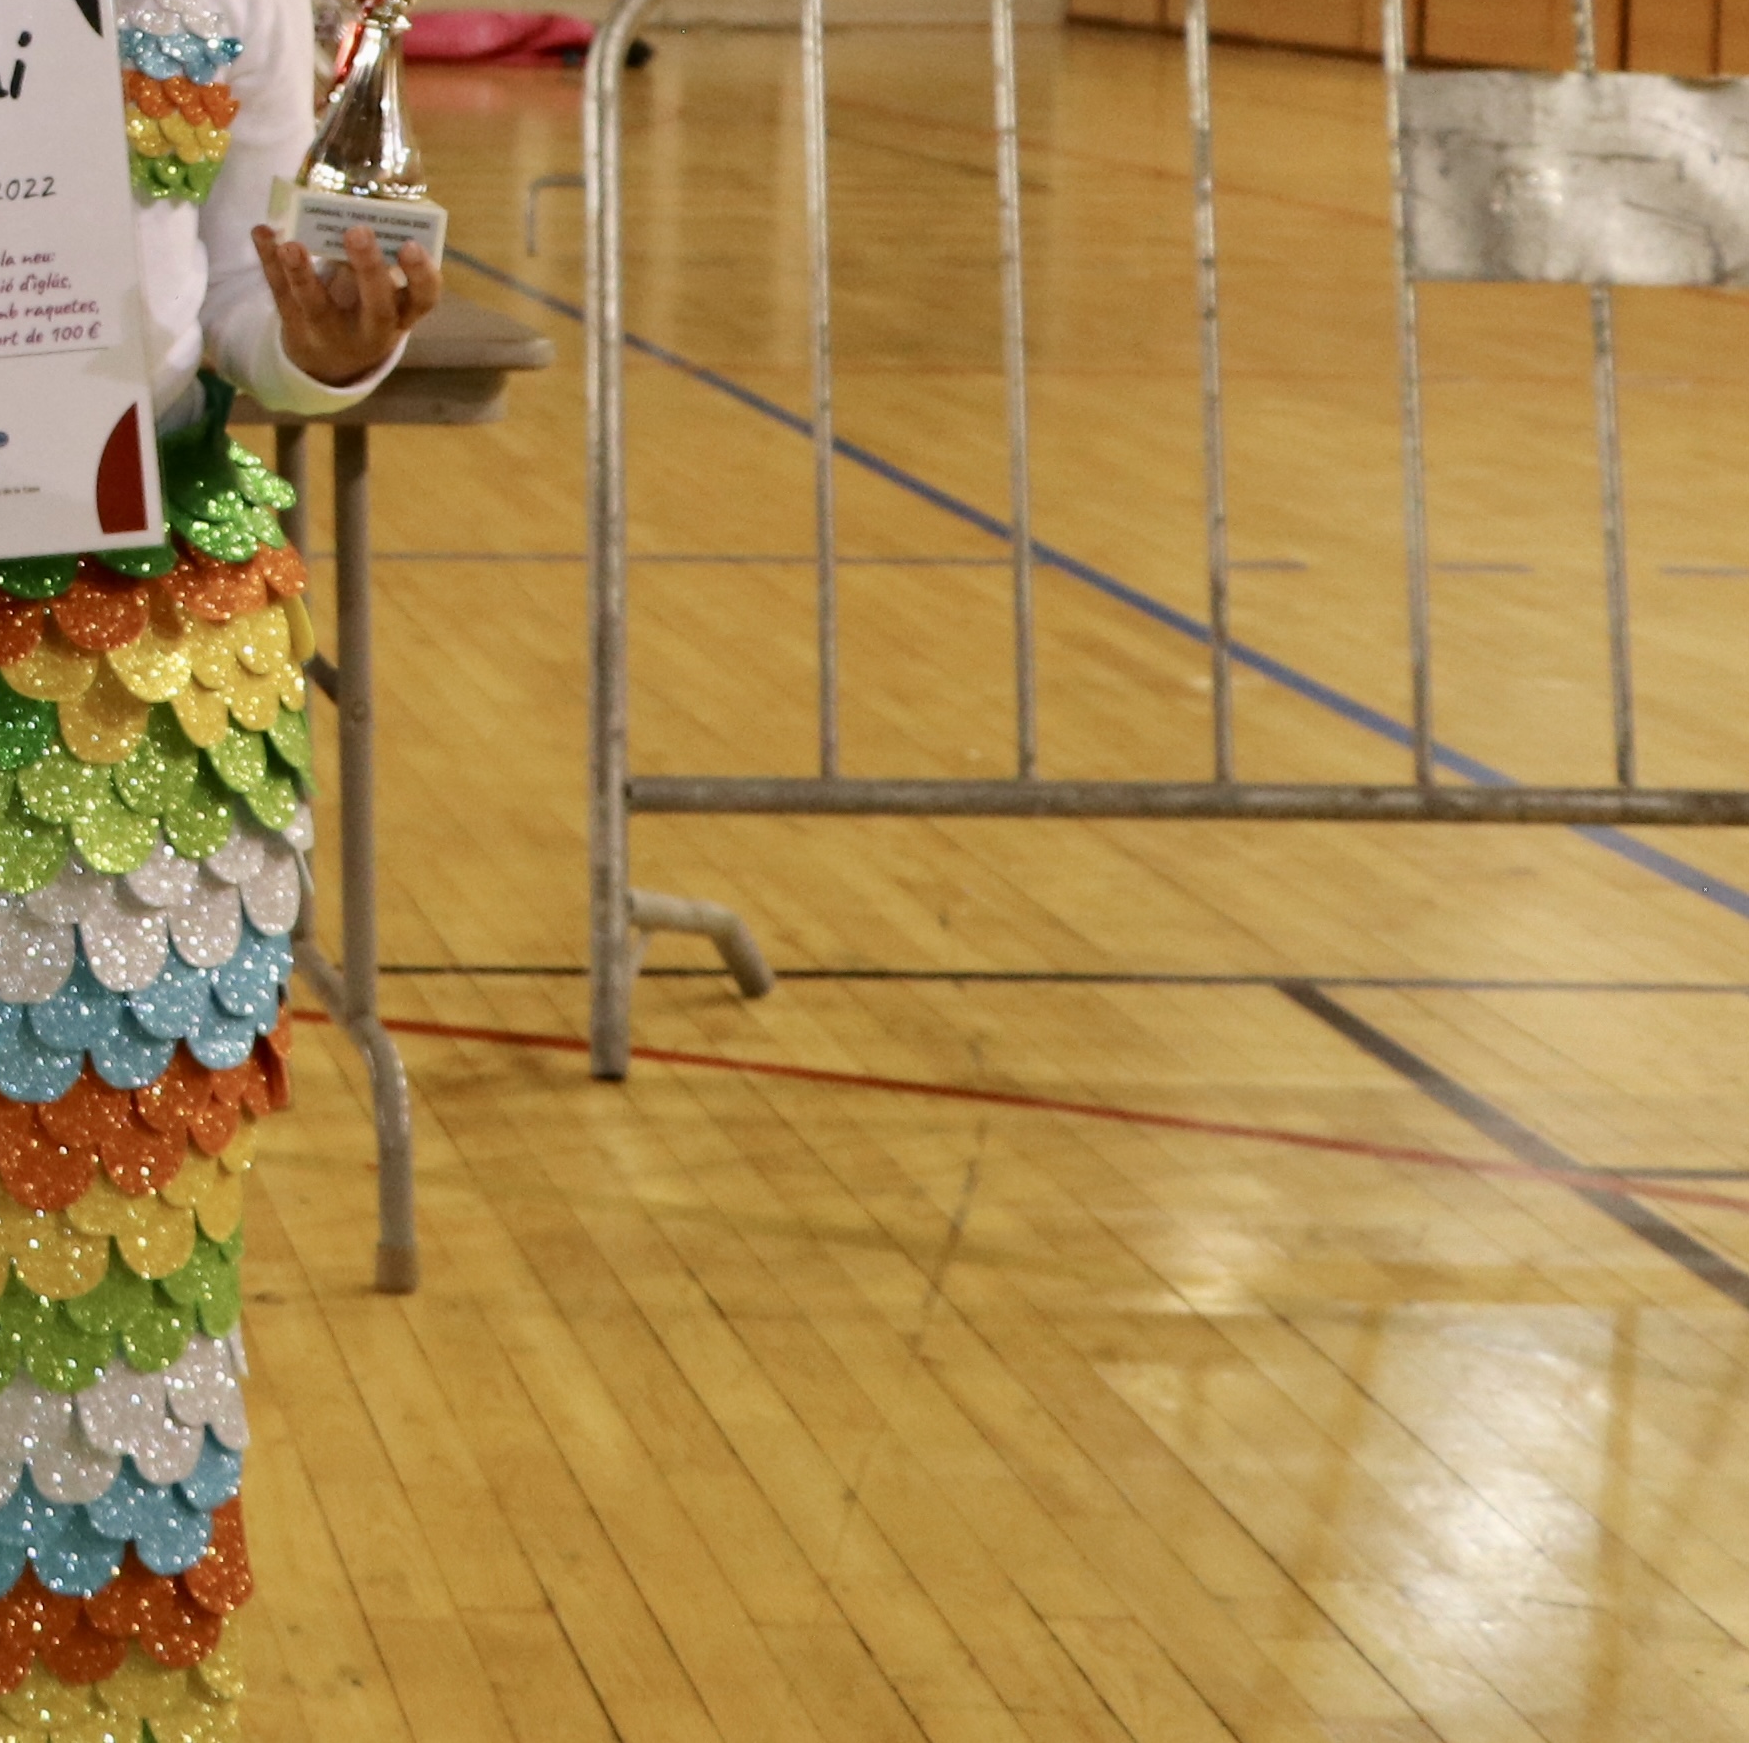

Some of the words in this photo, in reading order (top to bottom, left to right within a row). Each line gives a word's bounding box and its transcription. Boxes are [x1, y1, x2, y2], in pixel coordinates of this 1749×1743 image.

[0, 250, 16, 267] la
[25, 328, 43, 344] de
[51, 325, 84, 343] 100
